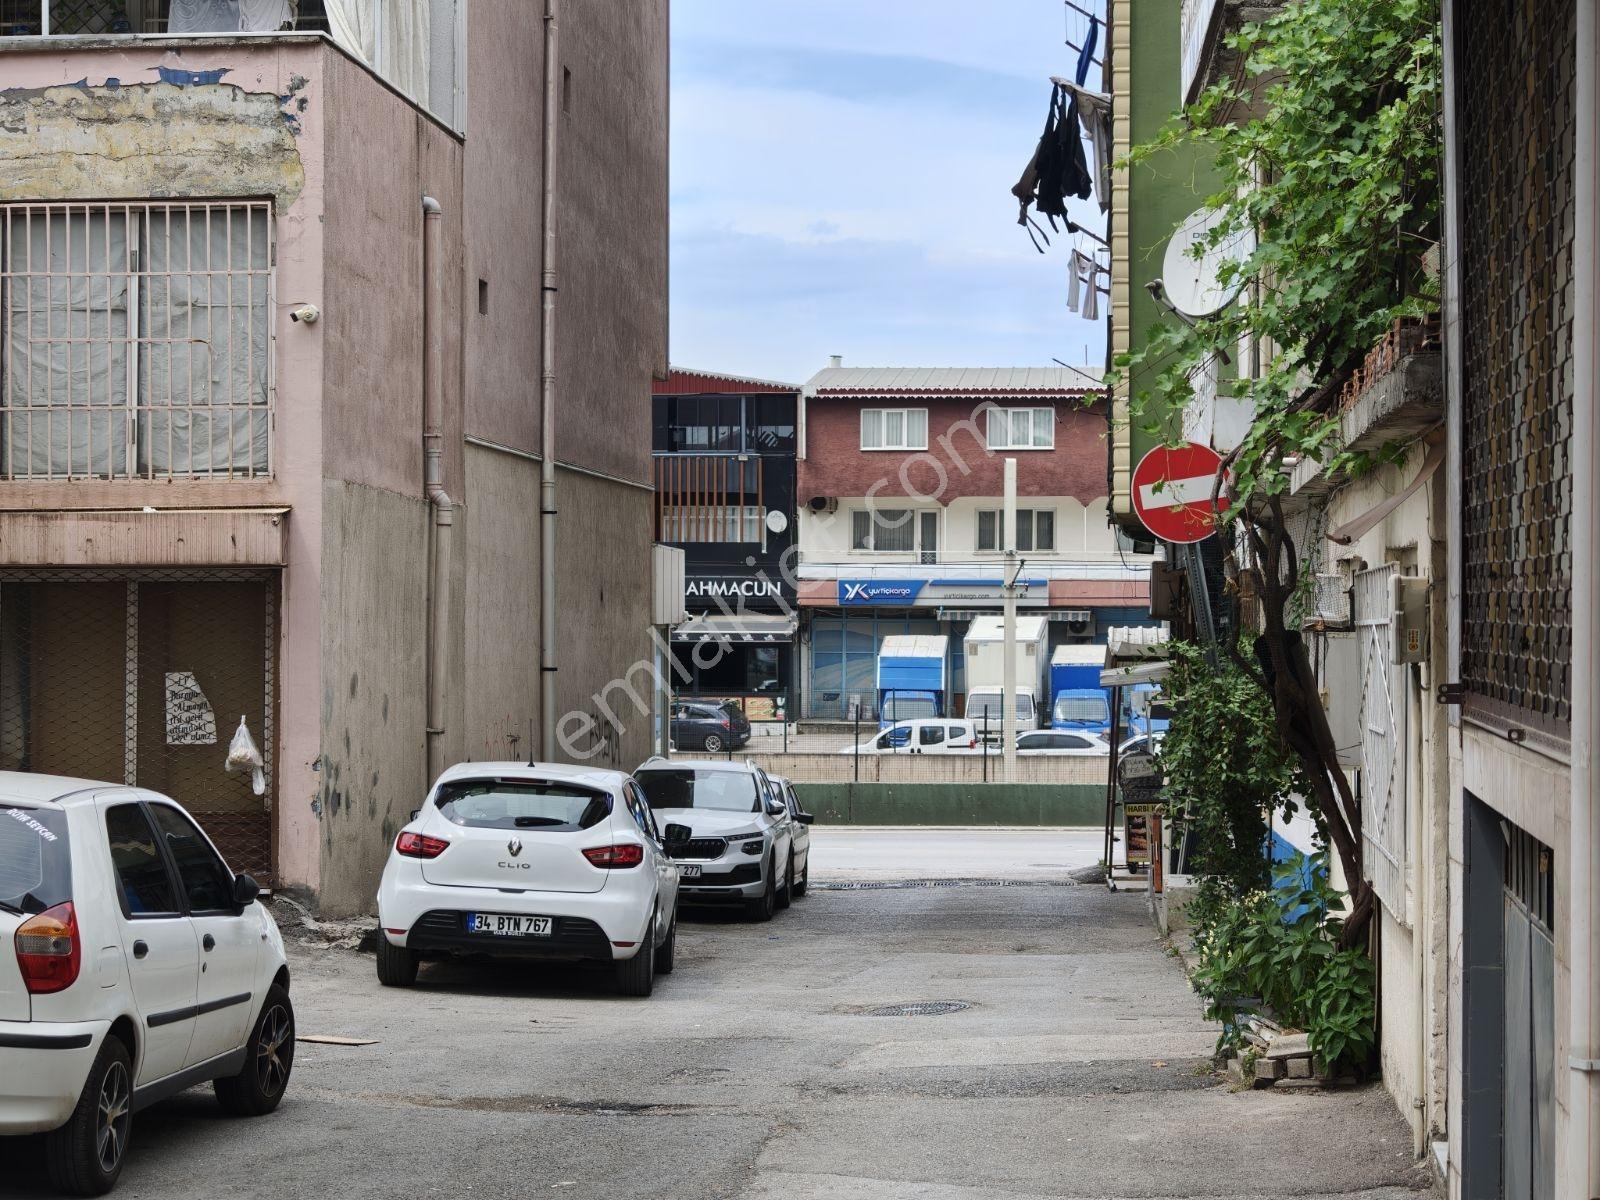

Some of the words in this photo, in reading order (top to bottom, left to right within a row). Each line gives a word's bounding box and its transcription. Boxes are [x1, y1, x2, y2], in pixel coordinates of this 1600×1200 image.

[685, 580, 782, 596] AHMACUN
[497, 861, 532, 870] CLIO
[684, 866, 700, 876] 277
[475, 915, 491, 930] 34
[497, 916, 521, 931] BTN
[526, 917, 549, 933] 767
